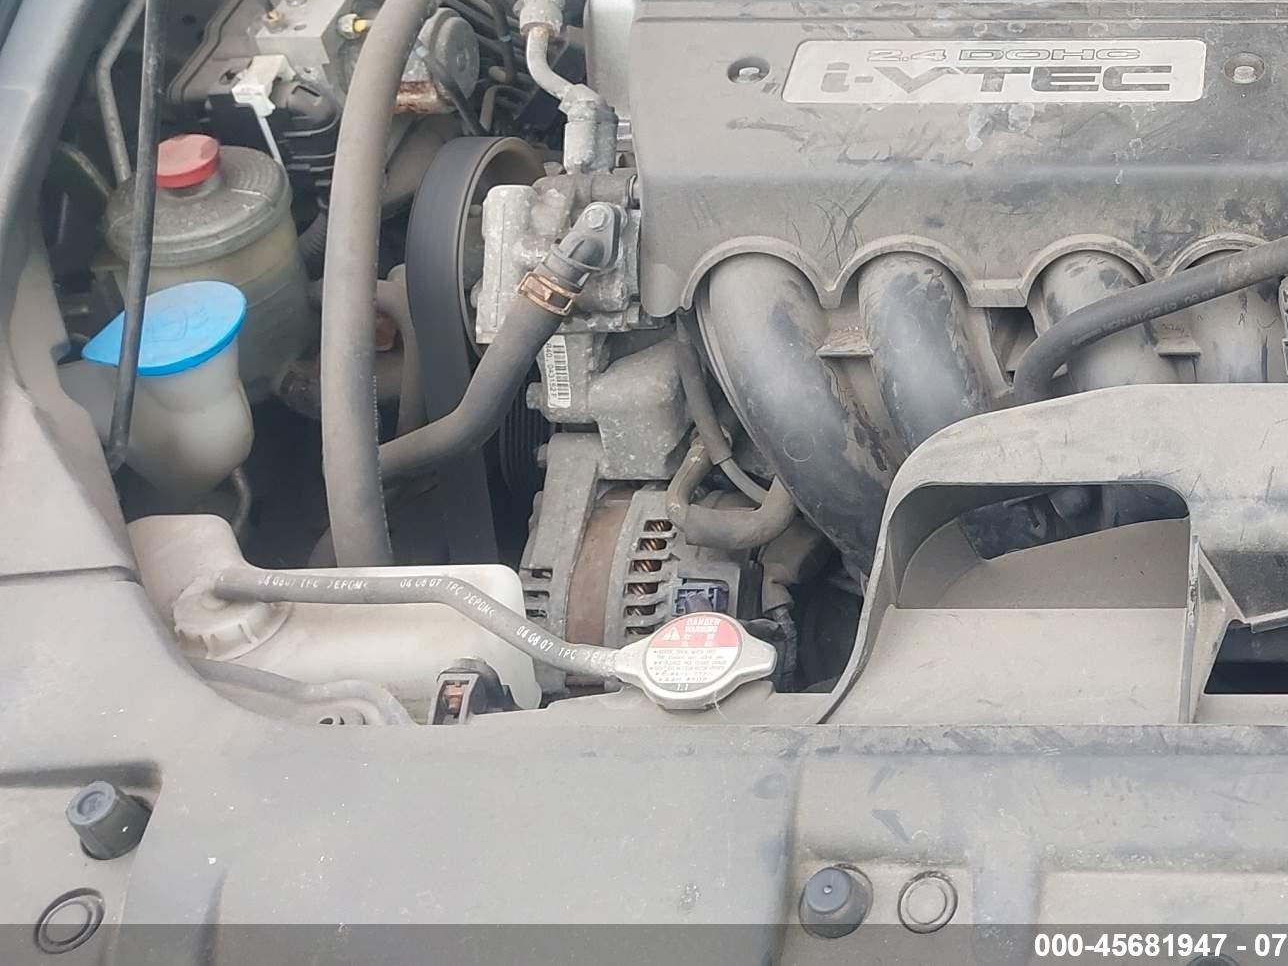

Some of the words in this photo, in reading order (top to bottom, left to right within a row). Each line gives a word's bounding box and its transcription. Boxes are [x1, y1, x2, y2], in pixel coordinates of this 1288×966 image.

[867, 48, 947, 62] 2.4
[958, 48, 1141, 62] DOHC
[820, 61, 1172, 94] i-VTEC
